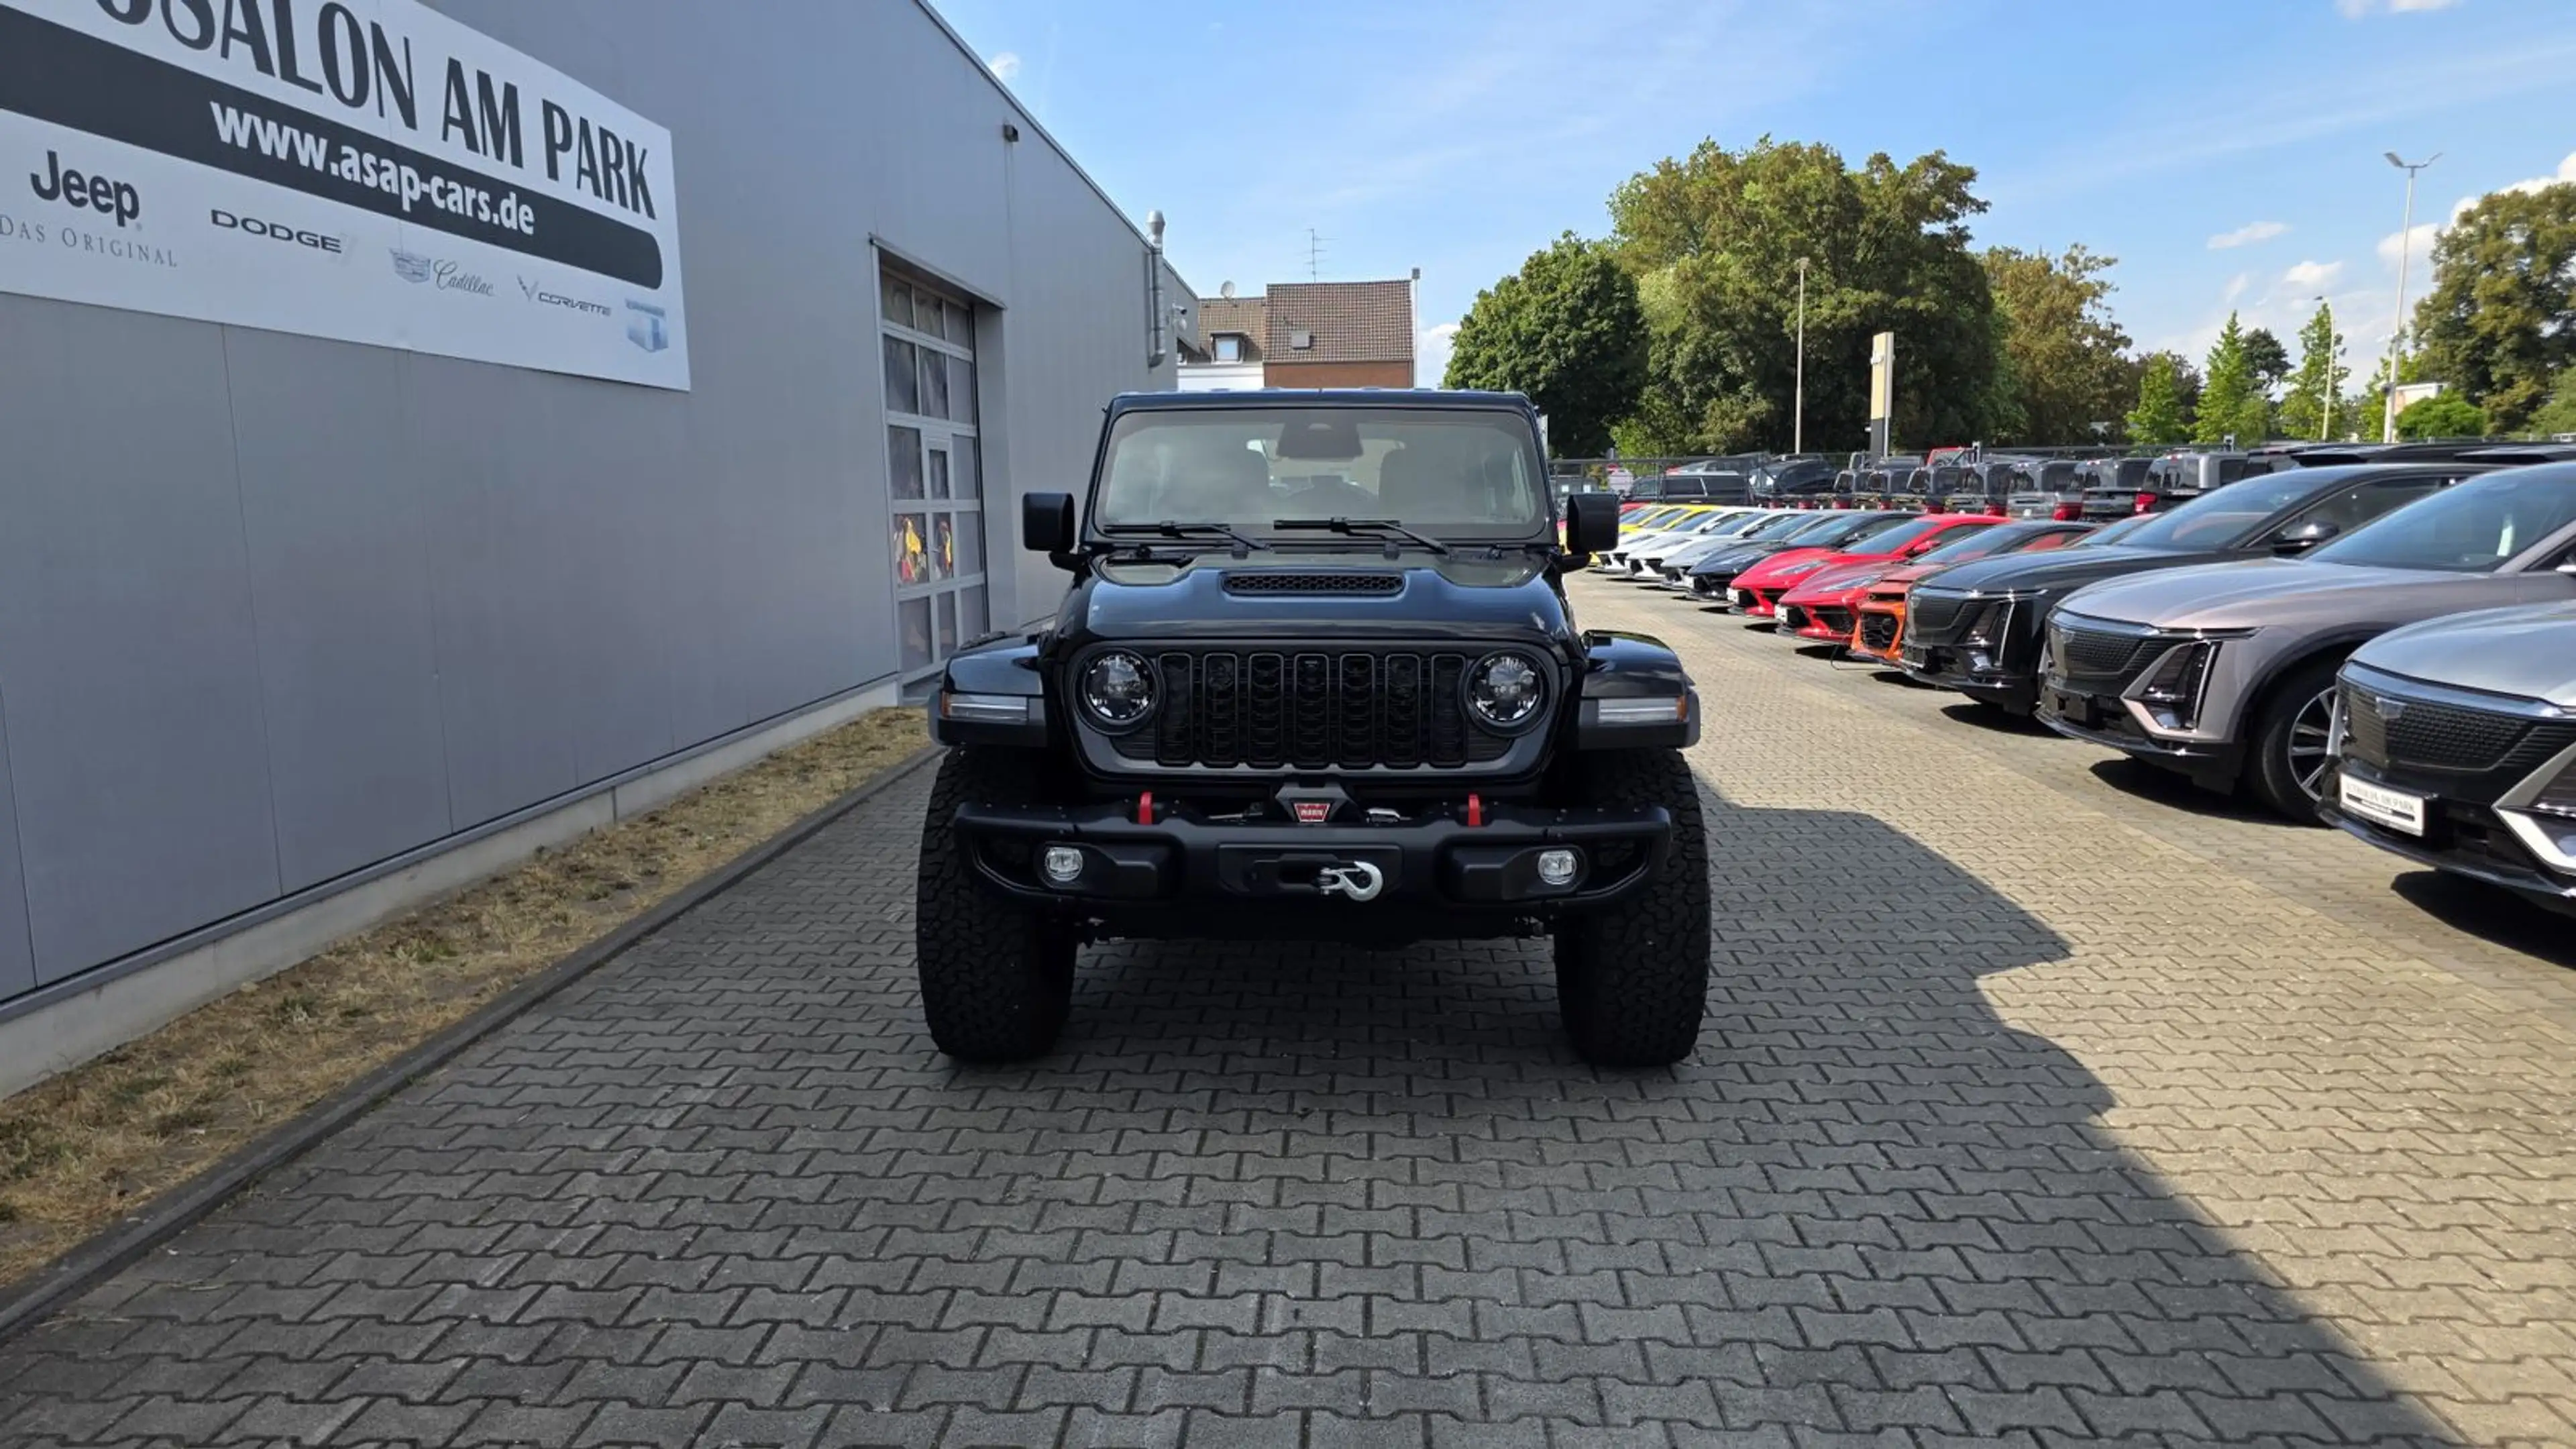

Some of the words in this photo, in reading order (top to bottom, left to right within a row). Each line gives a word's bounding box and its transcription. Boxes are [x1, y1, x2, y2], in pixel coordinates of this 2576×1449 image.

[441, 56, 524, 169] AM
[541, 98, 656, 220] PARK
[30, 149, 140, 227] Jeep
[209, 100, 535, 235] www.asap-cars.de
[0, 214, 46, 243] DAS
[62, 227, 177, 268] ORIGINAL
[210, 209, 342, 254] DODGE
[433, 258, 496, 297] Cadillac
[539, 291, 612, 317] CORVETTE
